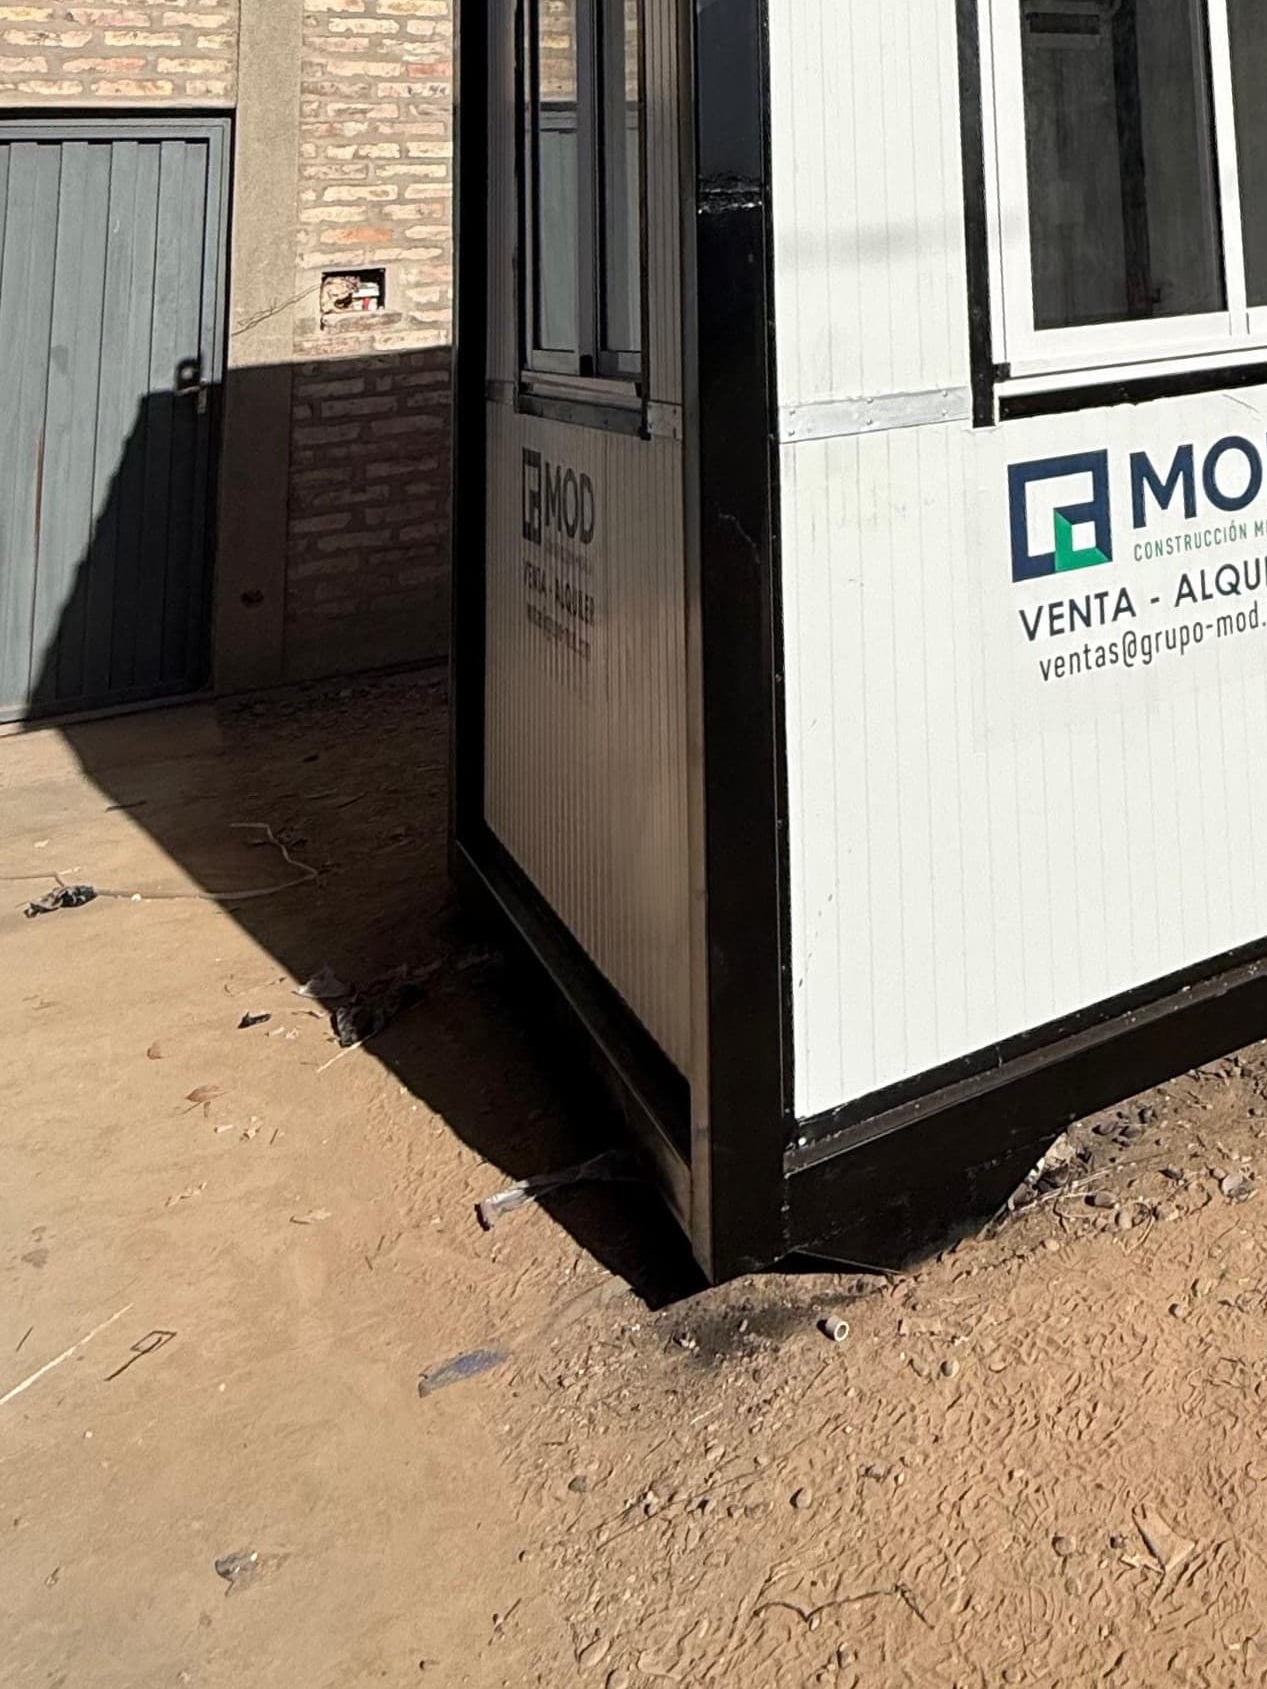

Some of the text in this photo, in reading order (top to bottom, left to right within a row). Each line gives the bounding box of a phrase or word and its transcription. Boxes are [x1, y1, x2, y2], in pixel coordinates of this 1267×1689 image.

[545, 462, 594, 545] MOD
[1134, 520, 1247, 561] CONSTRUCCIÓN
[1019, 587, 1137, 641] VENTA
